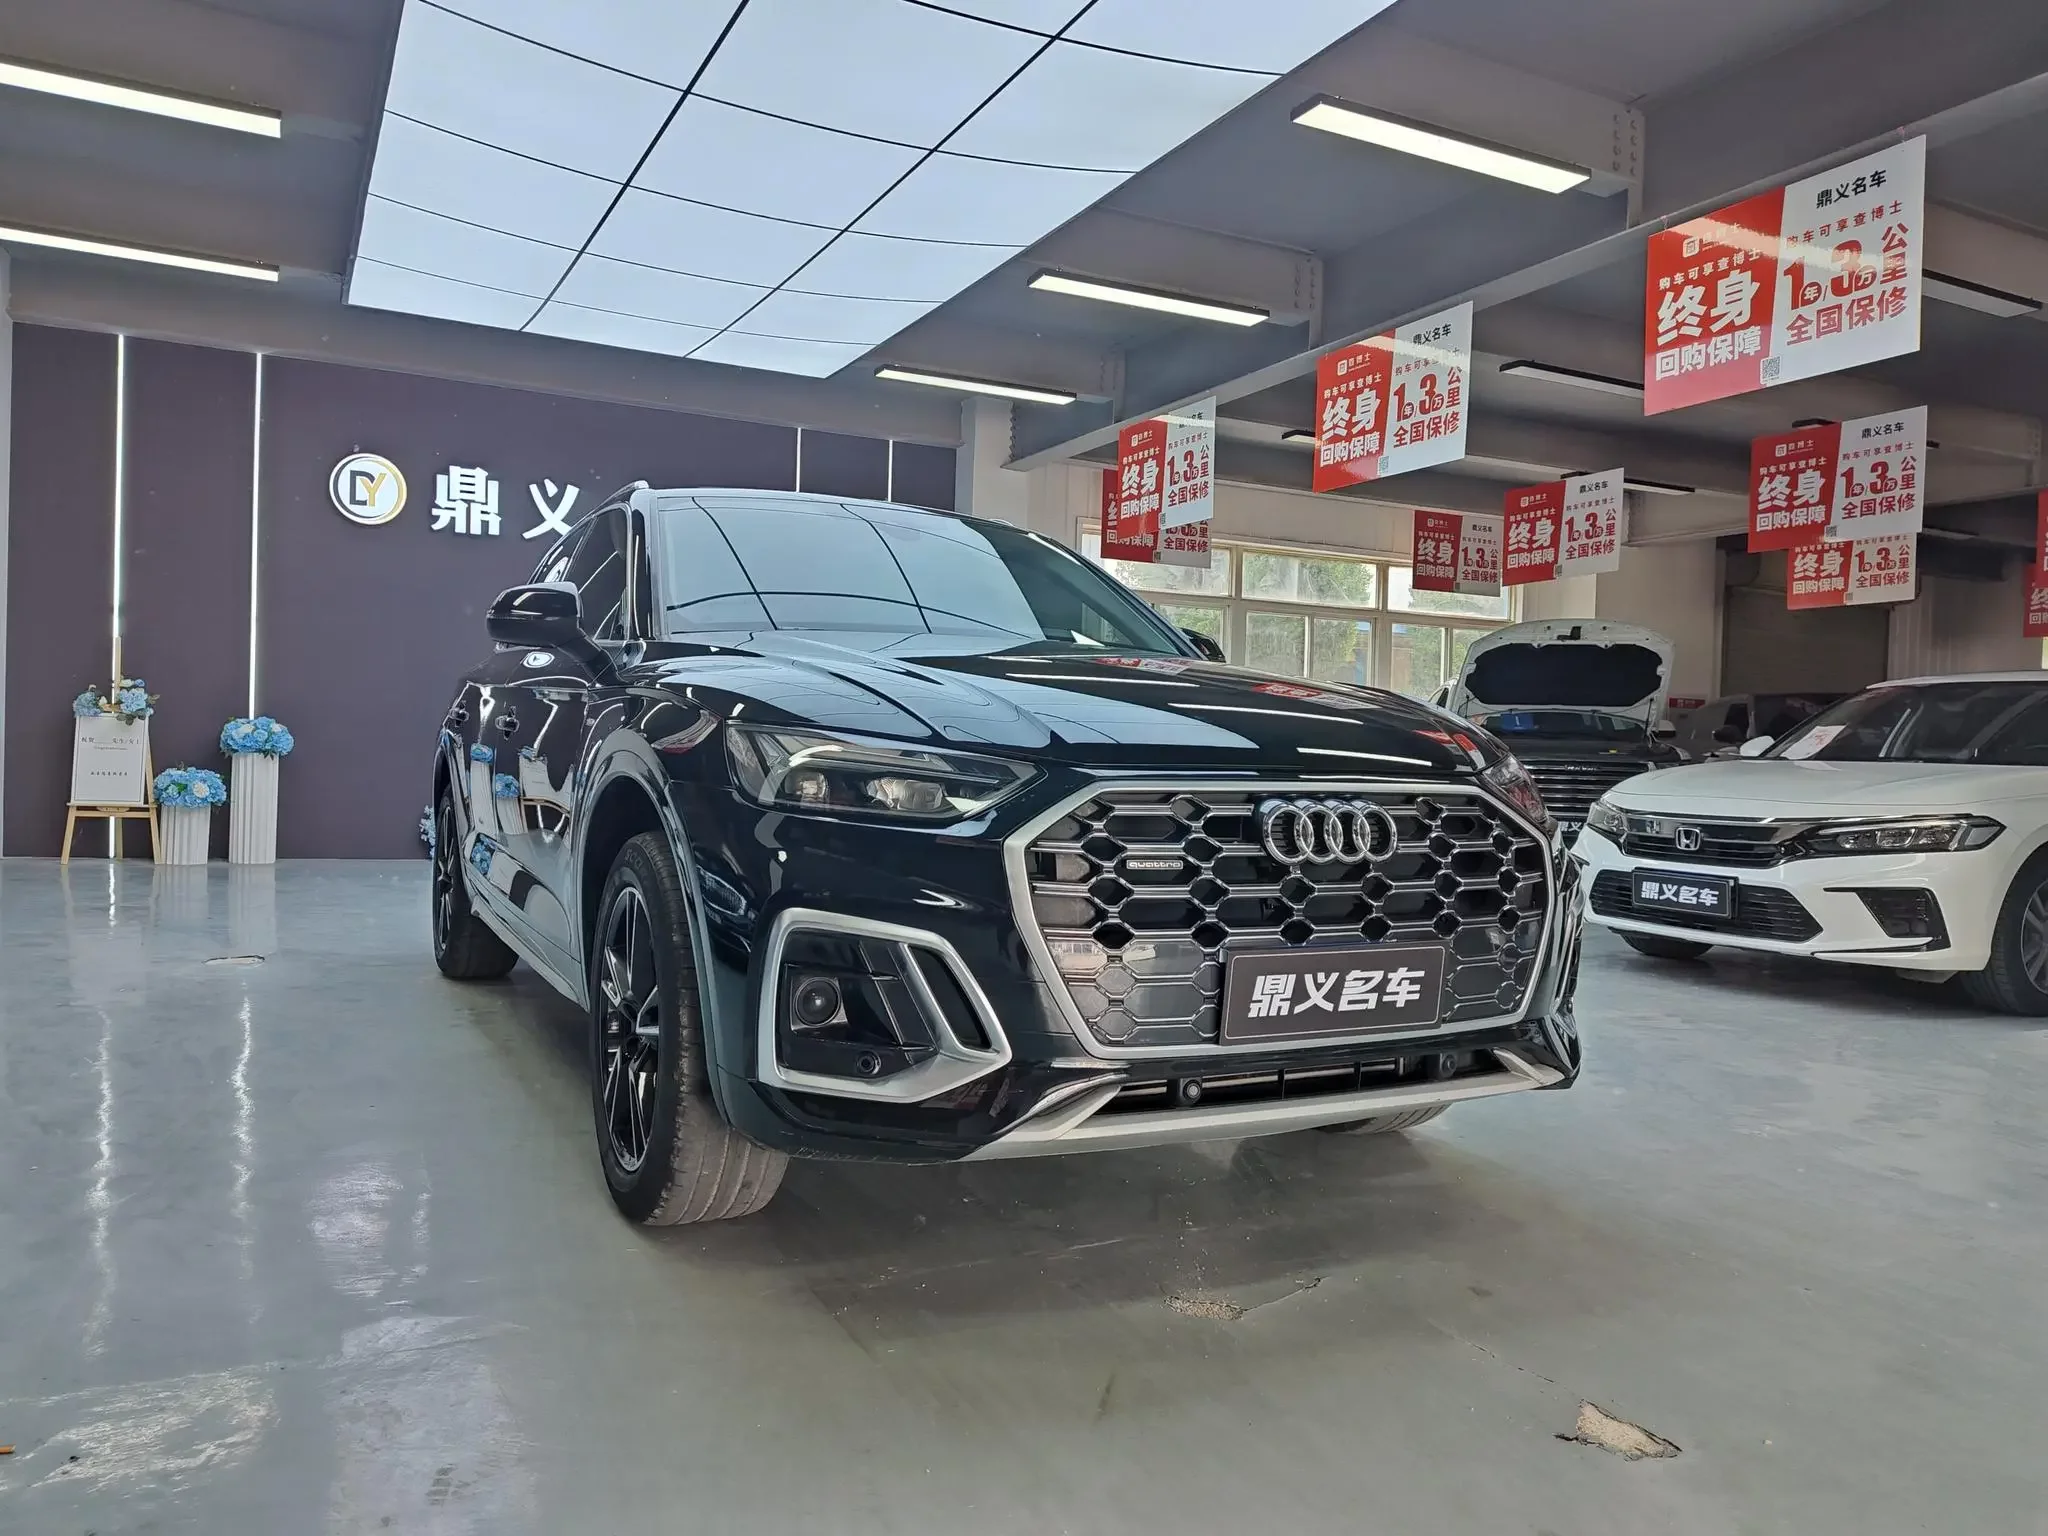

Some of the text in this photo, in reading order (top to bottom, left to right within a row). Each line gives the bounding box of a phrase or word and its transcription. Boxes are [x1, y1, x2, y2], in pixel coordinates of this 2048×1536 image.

[1816, 170, 1887, 209] 鼎义名车
[1786, 200, 1903, 250] 购车可享查博士
[1659, 247, 1761, 291] 购车可享查博士
[1656, 269, 1760, 346] 终身
[1786, 286, 1908, 346] 全国保修
[1413, 323, 1452, 345] 鼎义名车
[1655, 326, 1761, 381] 回购保障
[1322, 388, 1381, 440] 终身
[1393, 410, 1459, 448] 全国保修
[1861, 422, 1905, 439] 鼎义名车
[1320, 431, 1380, 468] 回购保障
[1121, 458, 1159, 499] 终身
[1167, 481, 1209, 507] 全国保修
[1758, 469, 1826, 510] 终身
[430, 465, 580, 540] 鼎义
[1120, 493, 1160, 520] 回购保障
[1841, 492, 1915, 520] 全国保修
[1507, 517, 1555, 551] 终身
[1756, 505, 1826, 532] 回购保障
[1164, 537, 1209, 553] 全国保修
[1417, 537, 1455, 564] 终身
[1507, 548, 1555, 569] 回购保障
[1565, 539, 1615, 560] 全国保修
[1793, 550, 1844, 578] 终身
[1855, 571, 1909, 588] 全国保修
[1128, 861, 1181, 869] quattro
[1641, 881, 1720, 907] 鼎义名车
[1247, 966, 1426, 1018] 鼎义名车
